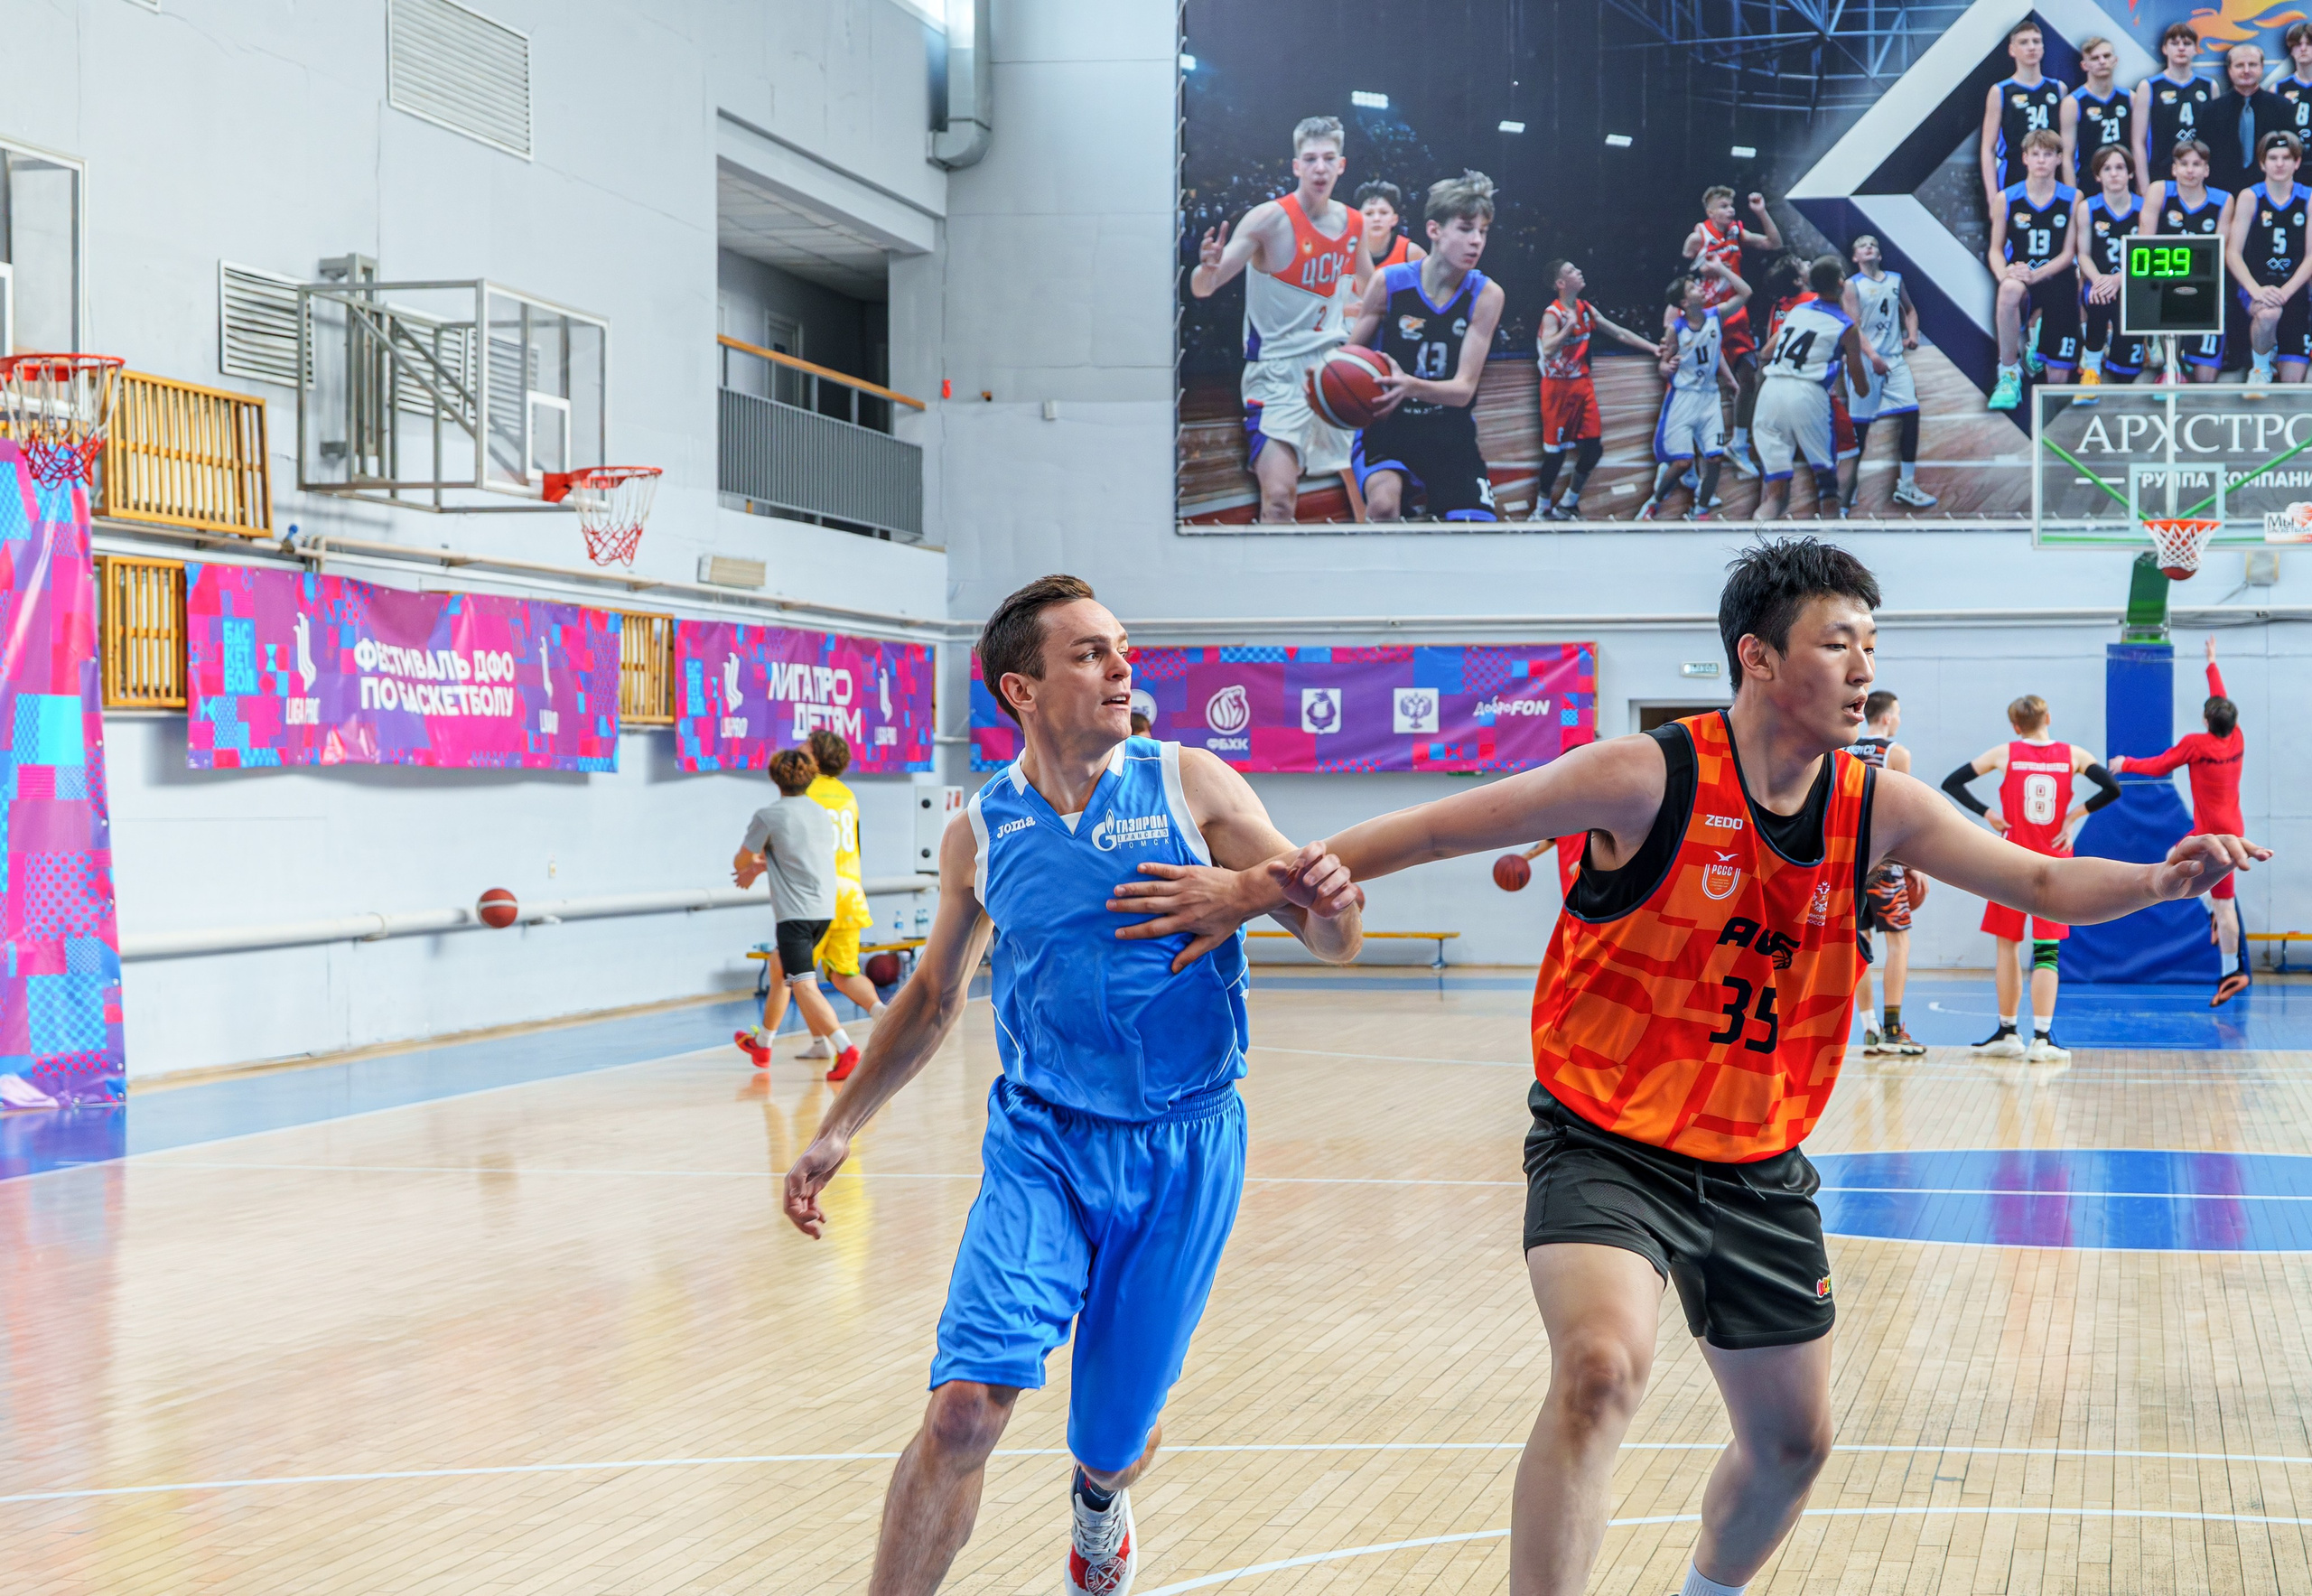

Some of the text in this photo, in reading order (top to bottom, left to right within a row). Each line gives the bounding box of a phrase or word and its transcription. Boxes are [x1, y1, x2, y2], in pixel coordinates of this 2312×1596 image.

[2026, 104, 2049, 131] 34
[2179, 102, 2194, 126] 4
[2101, 117, 2121, 144] 23
[2028, 229, 2051, 256] 13
[2106, 238, 2121, 263] 2
[2273, 228, 2287, 254] 5
[1313, 305, 1328, 331] 2
[1879, 298, 1888, 316] 4
[1414, 341, 1448, 379] 13
[2058, 337, 2075, 358] 13
[354, 638, 515, 683] ФЕСТИВАЛЬ ДФО
[360, 677, 398, 711] ПО
[2024, 774, 2057, 826] 8
[1116, 815, 1168, 834] ГАЗПРОМ
[1705, 814, 1743, 830] ZEDO
[1118, 839, 1170, 850] ТОМСК
[1709, 975, 1778, 1055] 35
